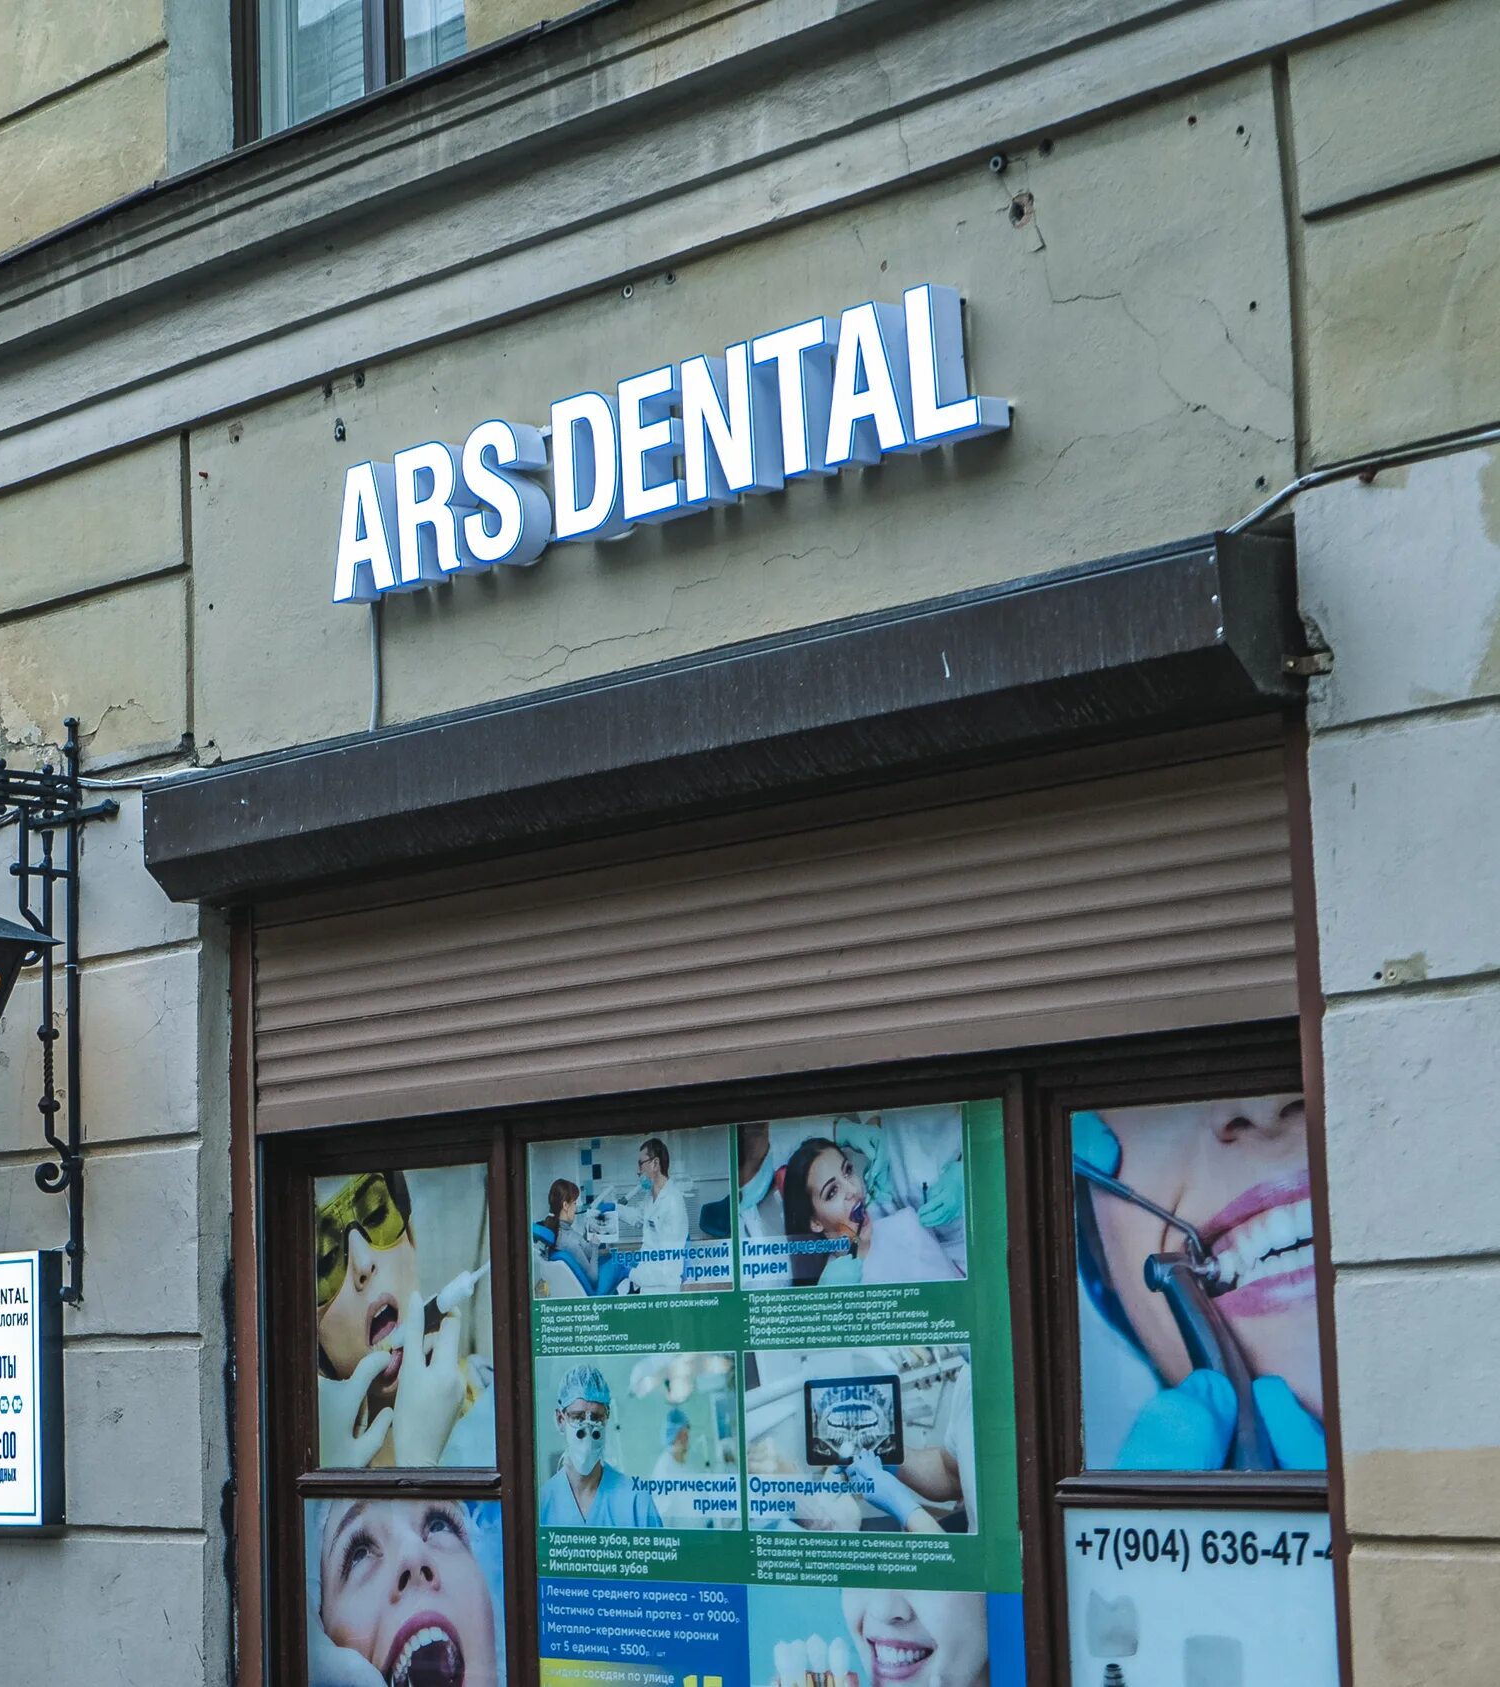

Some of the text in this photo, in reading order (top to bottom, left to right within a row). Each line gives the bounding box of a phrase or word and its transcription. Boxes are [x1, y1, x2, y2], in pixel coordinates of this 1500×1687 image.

[333, 283, 982, 604] ARS DENTAL
[611, 1243, 730, 1264] Терапевтический
[742, 1235, 850, 1257] Гигиенический
[686, 1264, 730, 1280] прием
[742, 1261, 788, 1278] прием
[749, 1292, 828, 1305] Профилактическая
[830, 1291, 865, 1300] гигиена
[904, 1288, 920, 1299] рта
[540, 1304, 572, 1313] Лечение
[574, 1304, 590, 1312] всех
[592, 1302, 612, 1312] форм
[614, 1302, 646, 1312] кариеса
[762, 1300, 842, 1315] профессиональной
[844, 1300, 898, 1311] аппаратуре
[540, 1316, 554, 1324] под
[750, 1310, 929, 1325] Индивидуальный подбор средств гигиены
[541, 1324, 573, 1333] Лечение
[750, 1324, 831, 1336] Профессиональная
[930, 1318, 956, 1330] зубов
[541, 1335, 573, 1344] Лечение
[542, 1344, 593, 1354] Эстетическое
[658, 1340, 680, 1352] зубов
[750, 1336, 805, 1345] Комплексное
[806, 1335, 842, 1344] лечение
[631, 1476, 737, 1495] Хирургический
[750, 1476, 875, 1496] Ортопедический
[693, 1498, 737, 1514] прием
[750, 1499, 796, 1513] прием
[548, 1532, 680, 1549] Удаление зубов, все виды
[756, 1534, 772, 1545] Все
[774, 1538, 797, 1548] виды
[905, 1540, 950, 1551] протезов
[548, 1546, 678, 1562] амбулаторных операций
[756, 1546, 803, 1557] Вставляем
[1075, 1528, 1190, 1572] +7(904)
[549, 1560, 648, 1576] Имплантация зубов
[805, 1562, 875, 1571] штампованные
[877, 1564, 917, 1574] коронки
[757, 1570, 838, 1584] Все виды виниров
[546, 1585, 589, 1599] Лечение
[592, 1589, 640, 1601] среднего
[642, 1590, 688, 1603] кариеса
[547, 1603, 594, 1617] Частично
[597, 1607, 643, 1619] съемный
[646, 1608, 682, 1622] протез
[692, 1611, 705, 1621] от
[547, 1622, 719, 1642] Металло-керамические коронки
[550, 1642, 561, 1651] от
[563, 1641, 570, 1651] 5
[572, 1643, 610, 1655] единиц
[582, 1668, 626, 1681] соседям
[627, 1672, 640, 1681] по
[643, 1673, 674, 1685] улице
